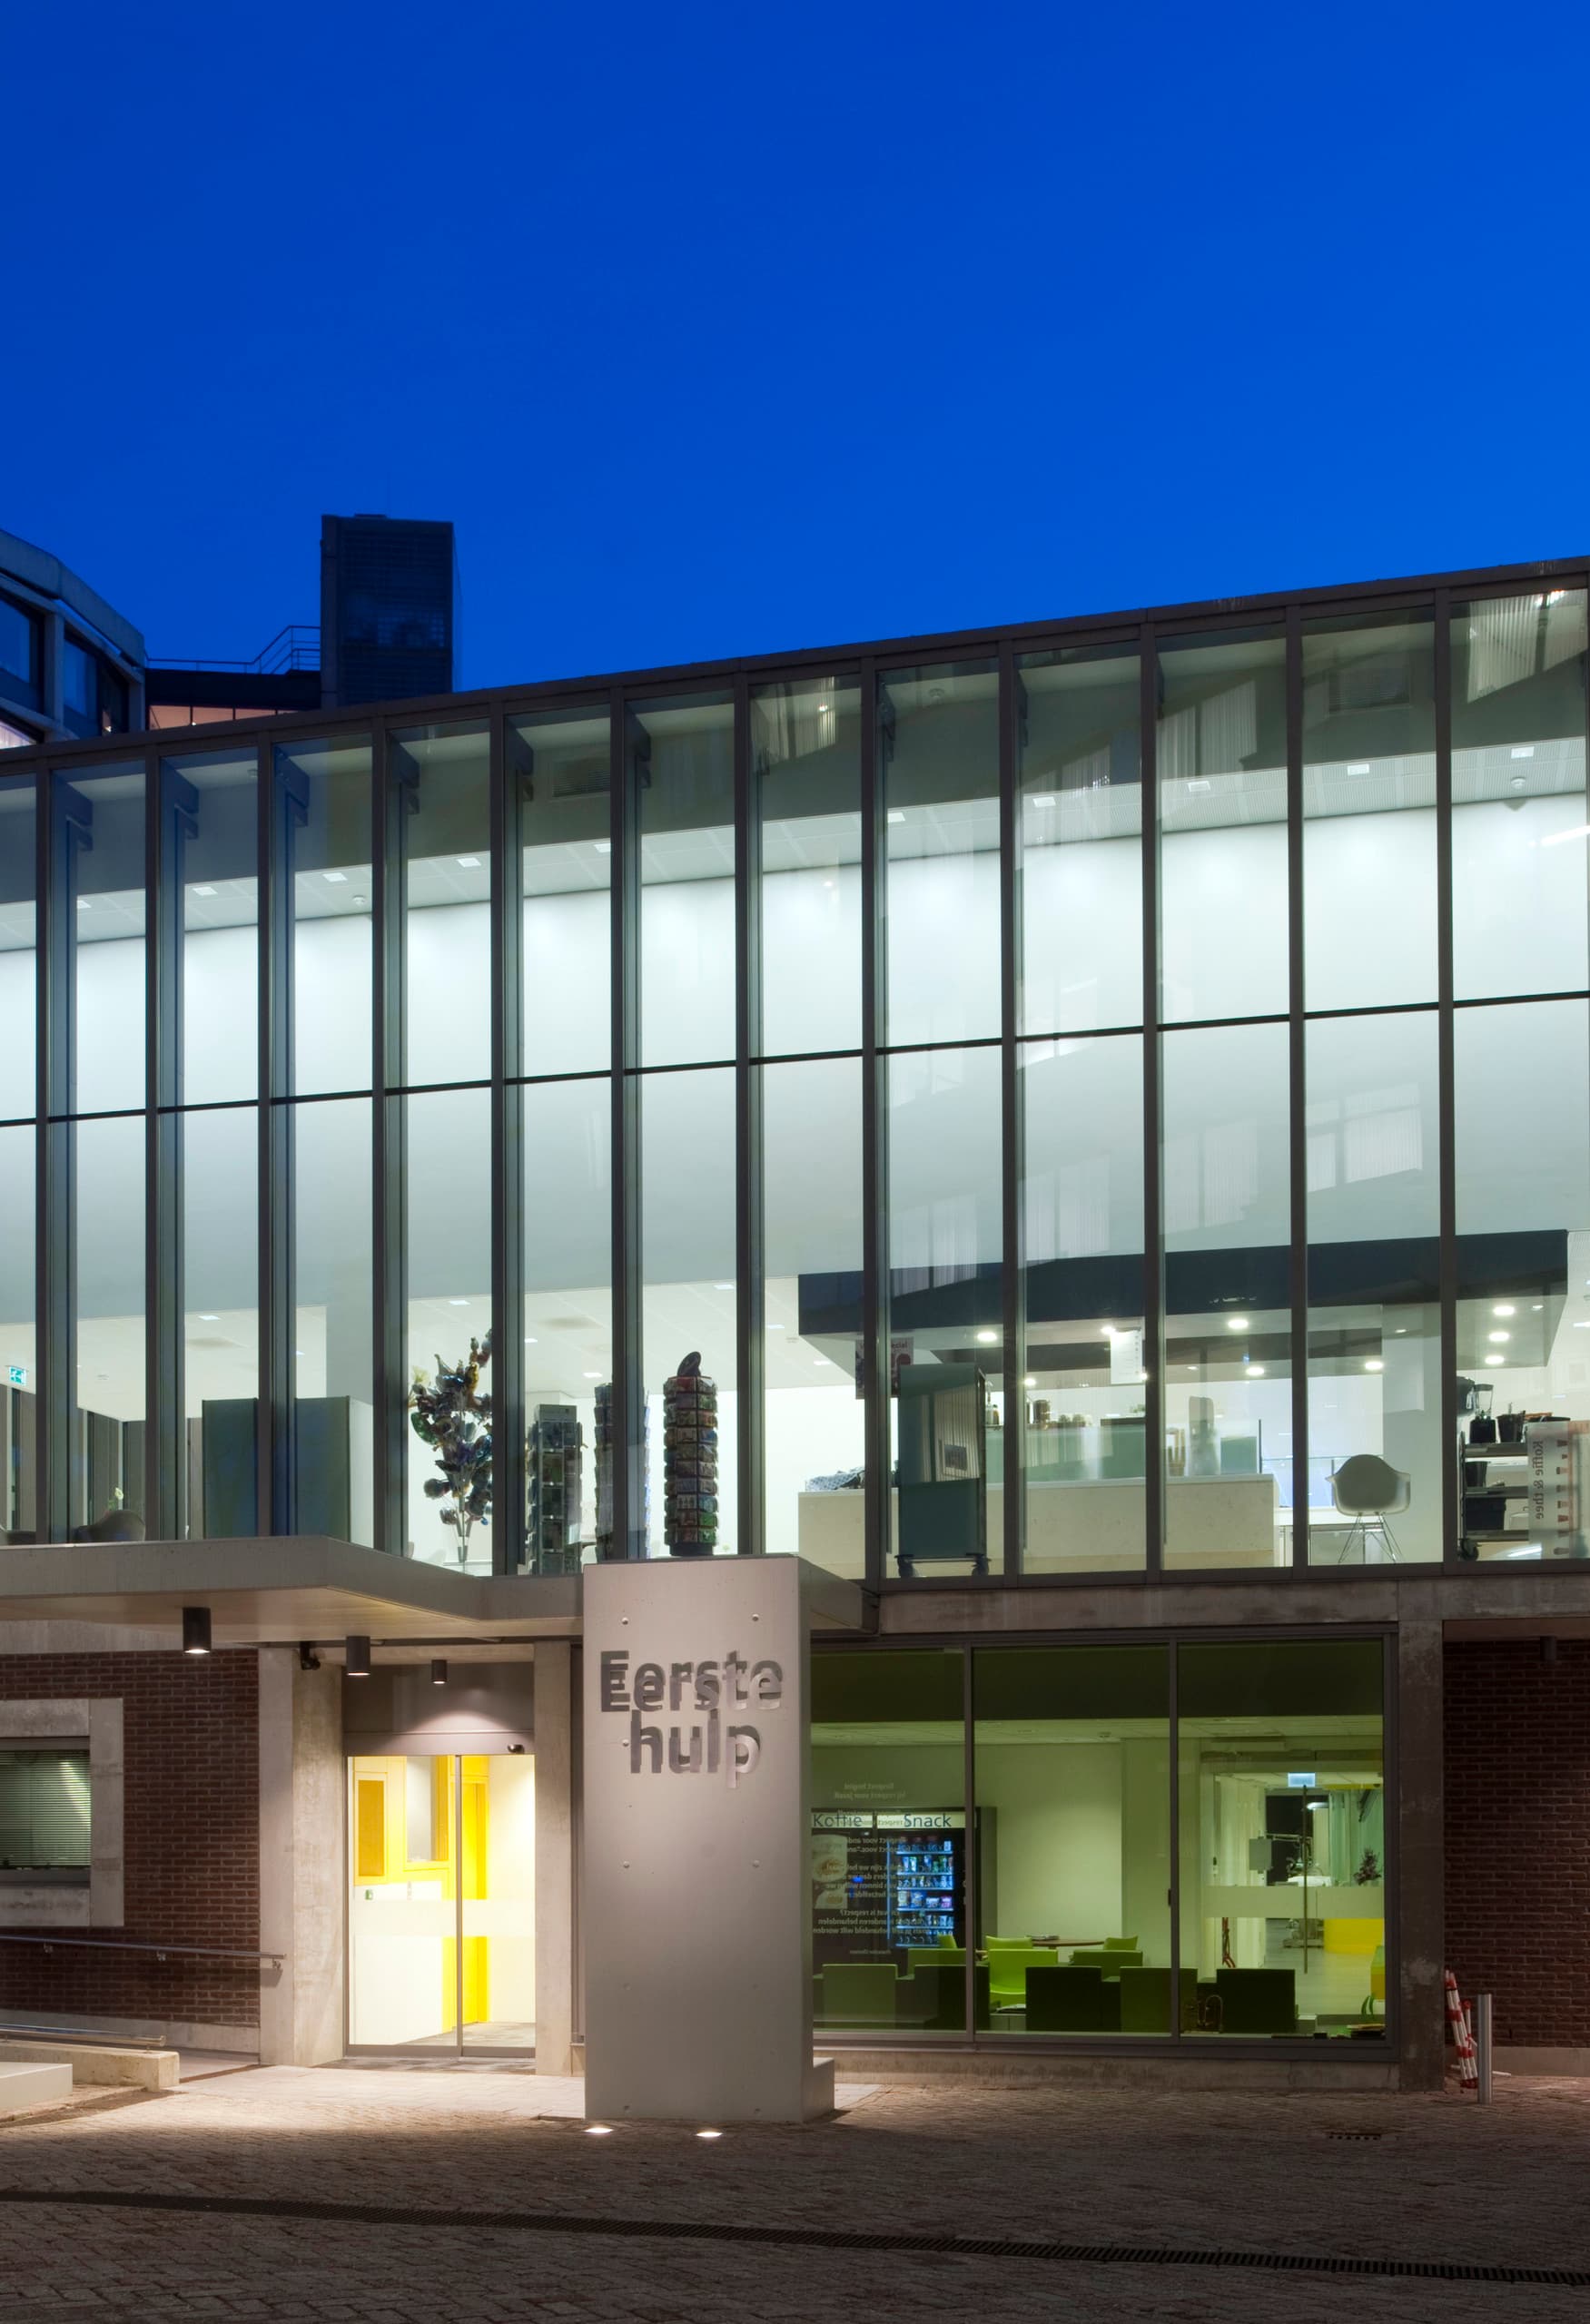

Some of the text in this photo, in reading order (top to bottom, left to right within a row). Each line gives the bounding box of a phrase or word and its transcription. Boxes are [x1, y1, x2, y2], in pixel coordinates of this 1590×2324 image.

[600, 1650, 783, 1712] Eerste
[630, 1709, 761, 1788] hulp
[813, 1813, 863, 1827] Koffie
[904, 1813, 953, 1827] Snack
